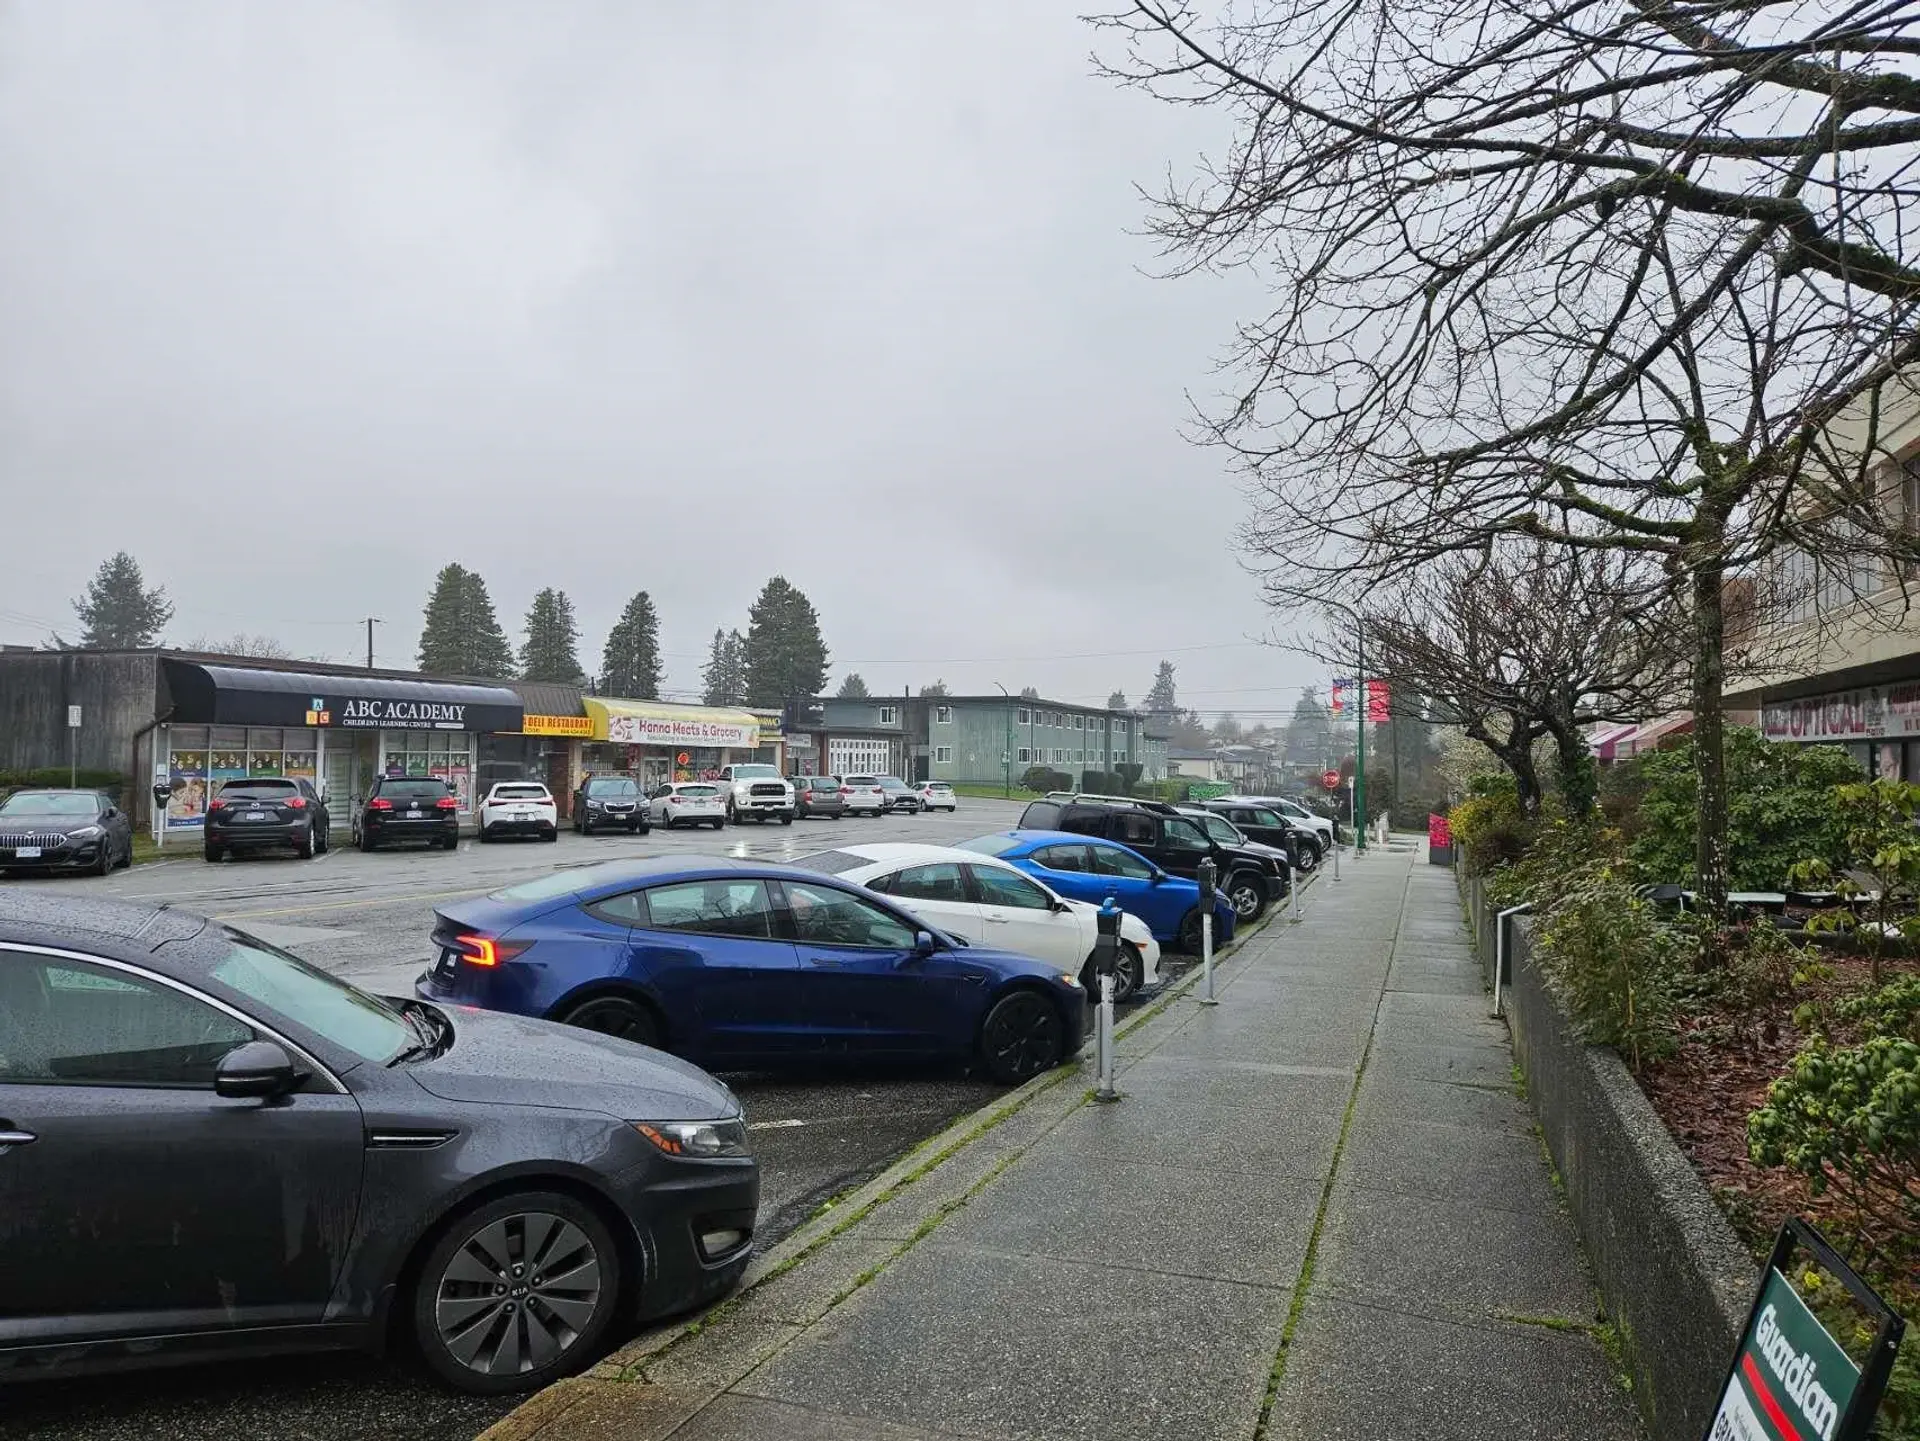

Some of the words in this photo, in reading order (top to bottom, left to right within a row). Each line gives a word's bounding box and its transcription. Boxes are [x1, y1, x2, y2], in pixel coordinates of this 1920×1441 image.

[343, 700, 382, 718] ABC
[384, 702, 466, 721] ACADEMY
[1791, 692, 1866, 738] OPTICAL
[379, 720, 408, 728] LEARNING
[527, 716, 545, 727] DELI
[547, 716, 593, 729] RESTAURANT
[639, 720, 671, 734] Hanna
[672, 722, 700, 736] Meats
[702, 724, 709, 736] &
[710, 725, 742, 741] Grocery
[511, 1287, 528, 1296] KIA
[1755, 1303, 1839, 1441] Guardian
